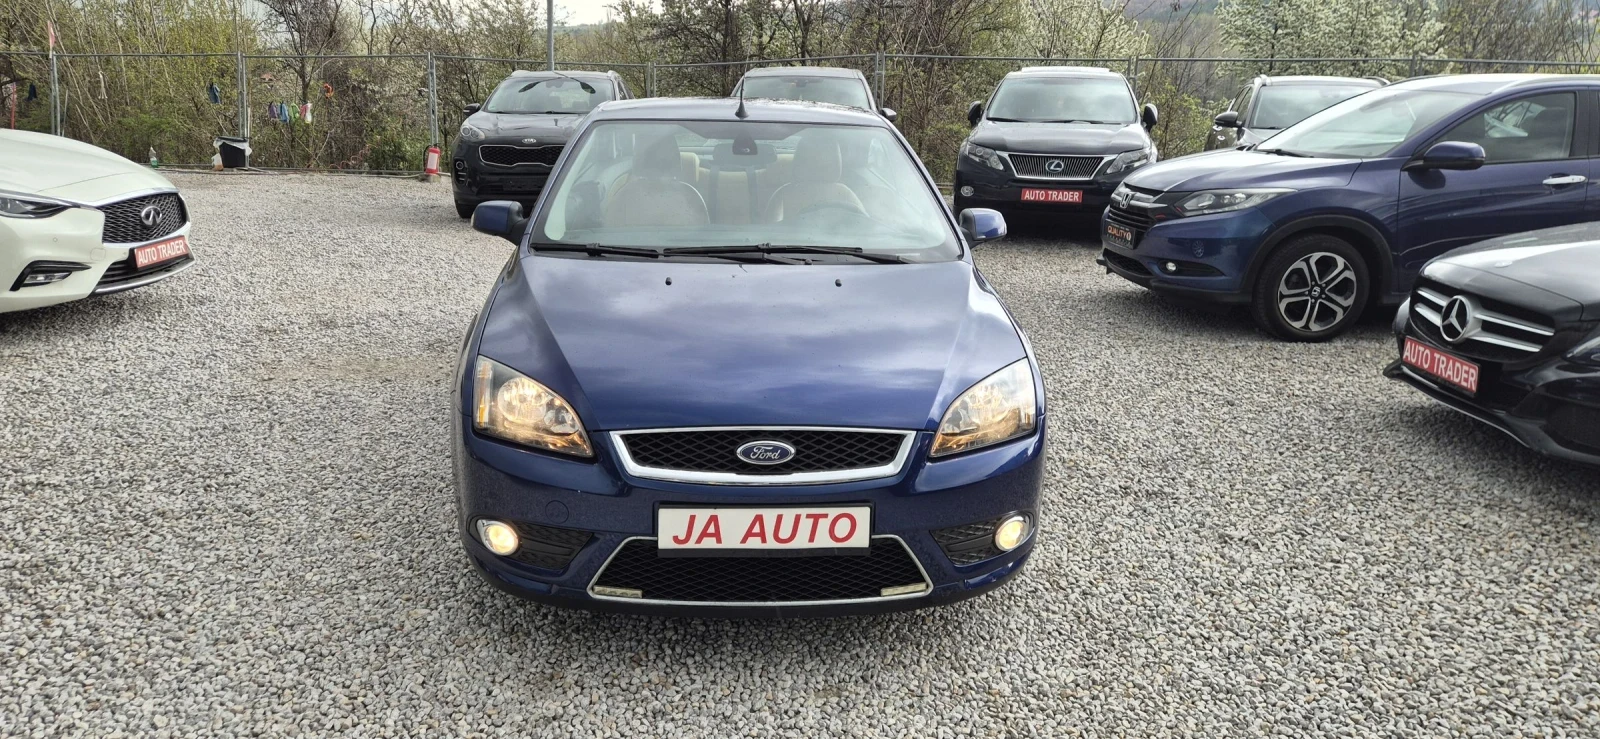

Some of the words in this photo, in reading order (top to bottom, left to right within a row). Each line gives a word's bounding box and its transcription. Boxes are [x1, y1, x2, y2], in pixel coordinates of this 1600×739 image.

[1024, 190, 1045, 201] AUTO
[1047, 191, 1080, 202] TRADER
[138, 247, 157, 264] AUTO
[157, 240, 186, 259] TRADER
[1402, 341, 1431, 369] AUTO
[1433, 352, 1476, 391] TRADER
[750, 446, 781, 460] Ford
[672, 514, 723, 545] JA
[739, 512, 857, 544] AUTO
